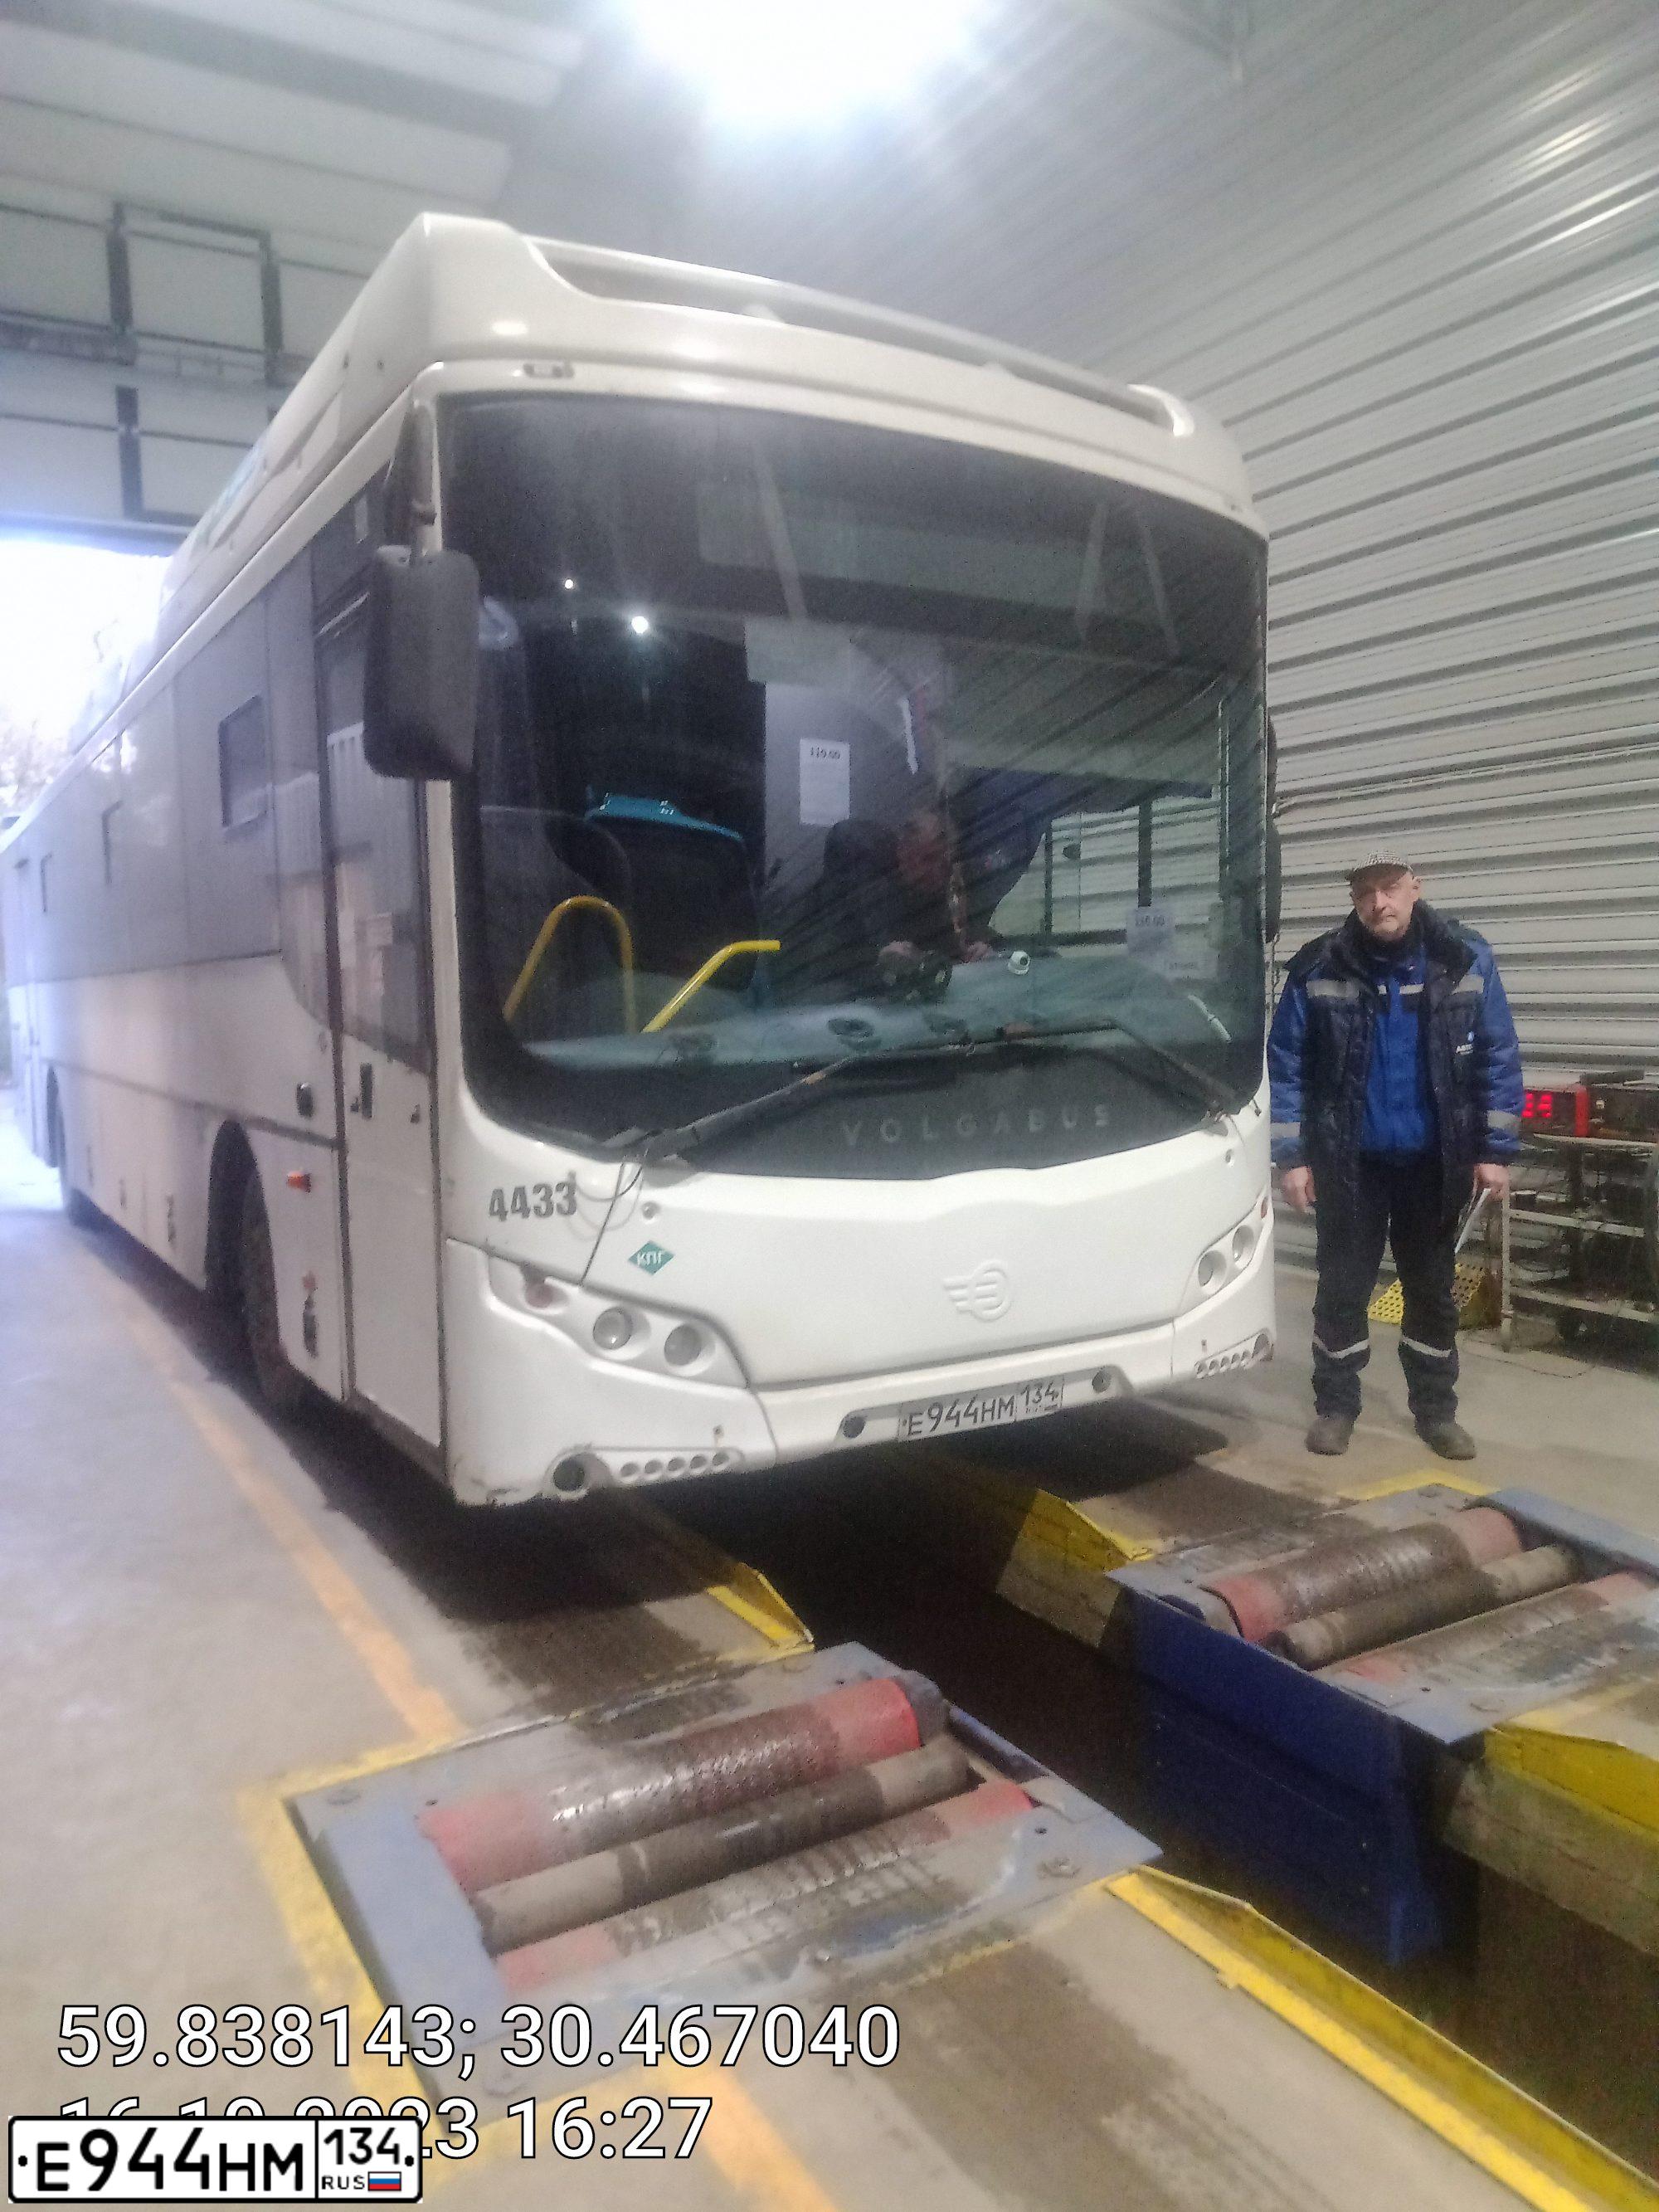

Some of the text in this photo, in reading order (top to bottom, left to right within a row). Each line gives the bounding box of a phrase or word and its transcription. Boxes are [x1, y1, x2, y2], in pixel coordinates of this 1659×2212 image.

[841, 1104, 1110, 1146] VOLGABUS
[489, 1182, 577, 1222] 4433
[636, 1250, 664, 1266] КПГ
[1020, 1381, 1058, 1406] 134
